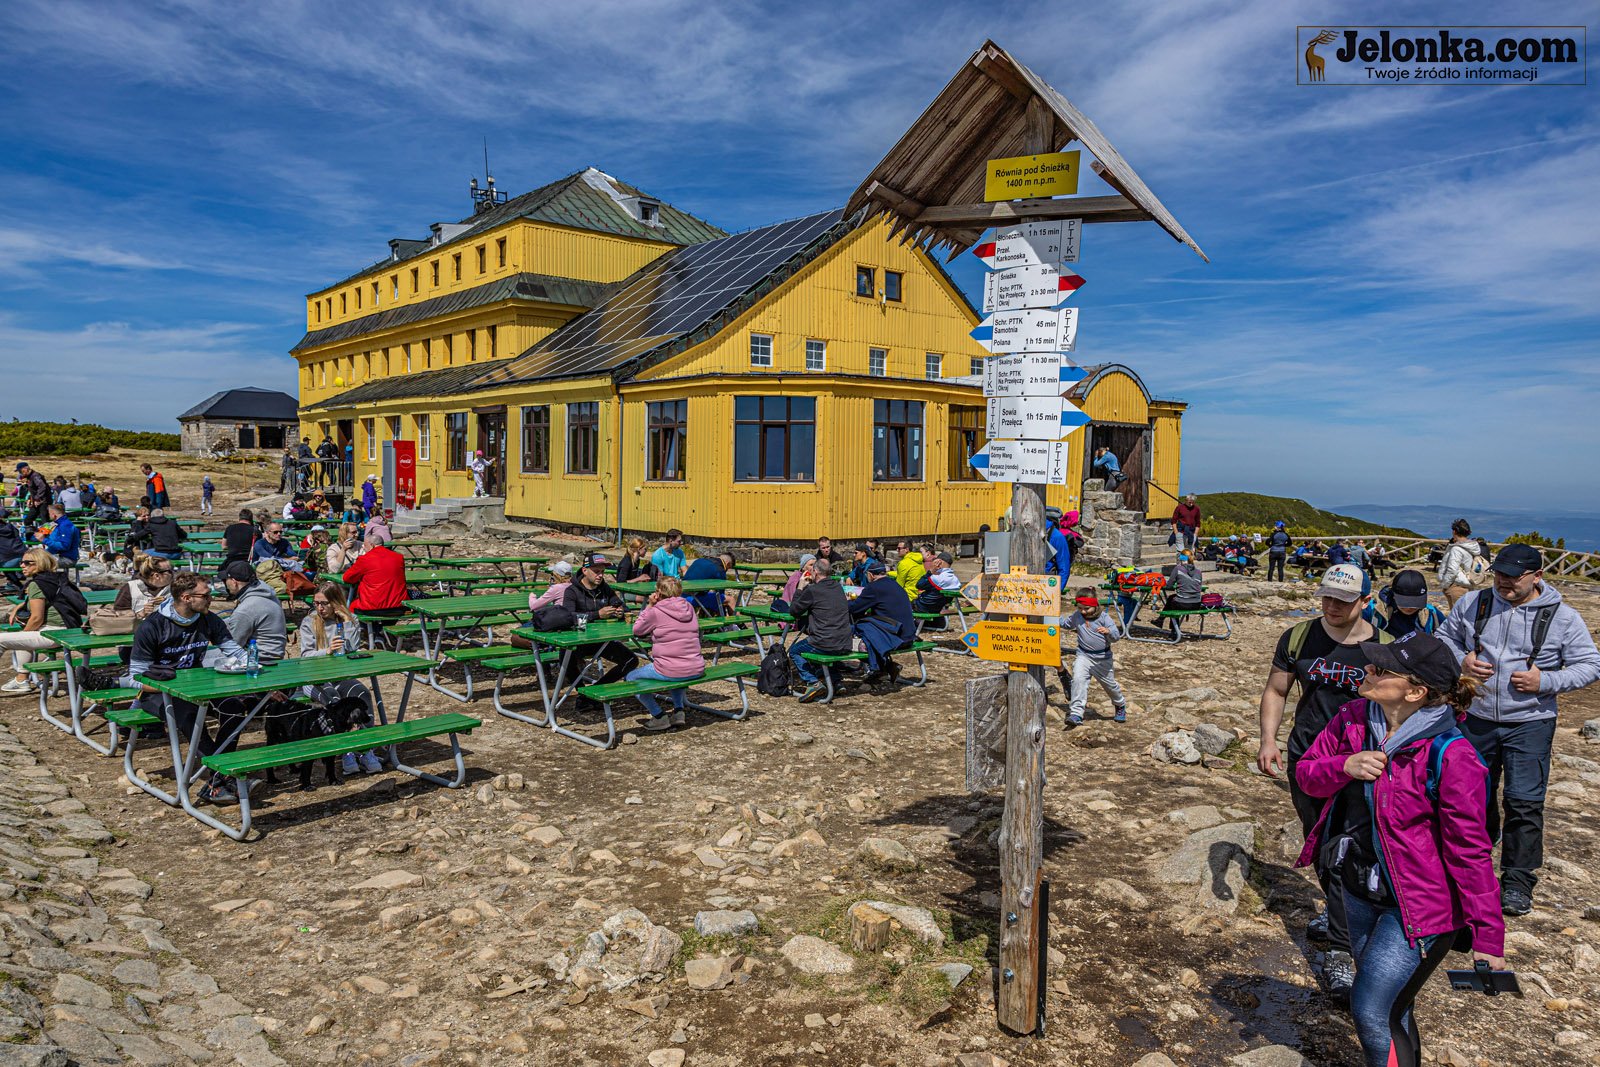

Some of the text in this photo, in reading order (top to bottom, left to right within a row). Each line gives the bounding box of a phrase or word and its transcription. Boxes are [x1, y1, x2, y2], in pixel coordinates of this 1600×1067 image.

[996, 162, 1070, 178] Równia pod Śnieżką
[1006, 178, 1022, 188] 1400
[1034, 177, 1056, 186] n.p.m.
[996, 252, 1026, 262] Karkonoska
[992, 634, 1020, 642] POLANA
[993, 644, 1013, 652] WANG
[1308, 657, 1364, 686] AIR
